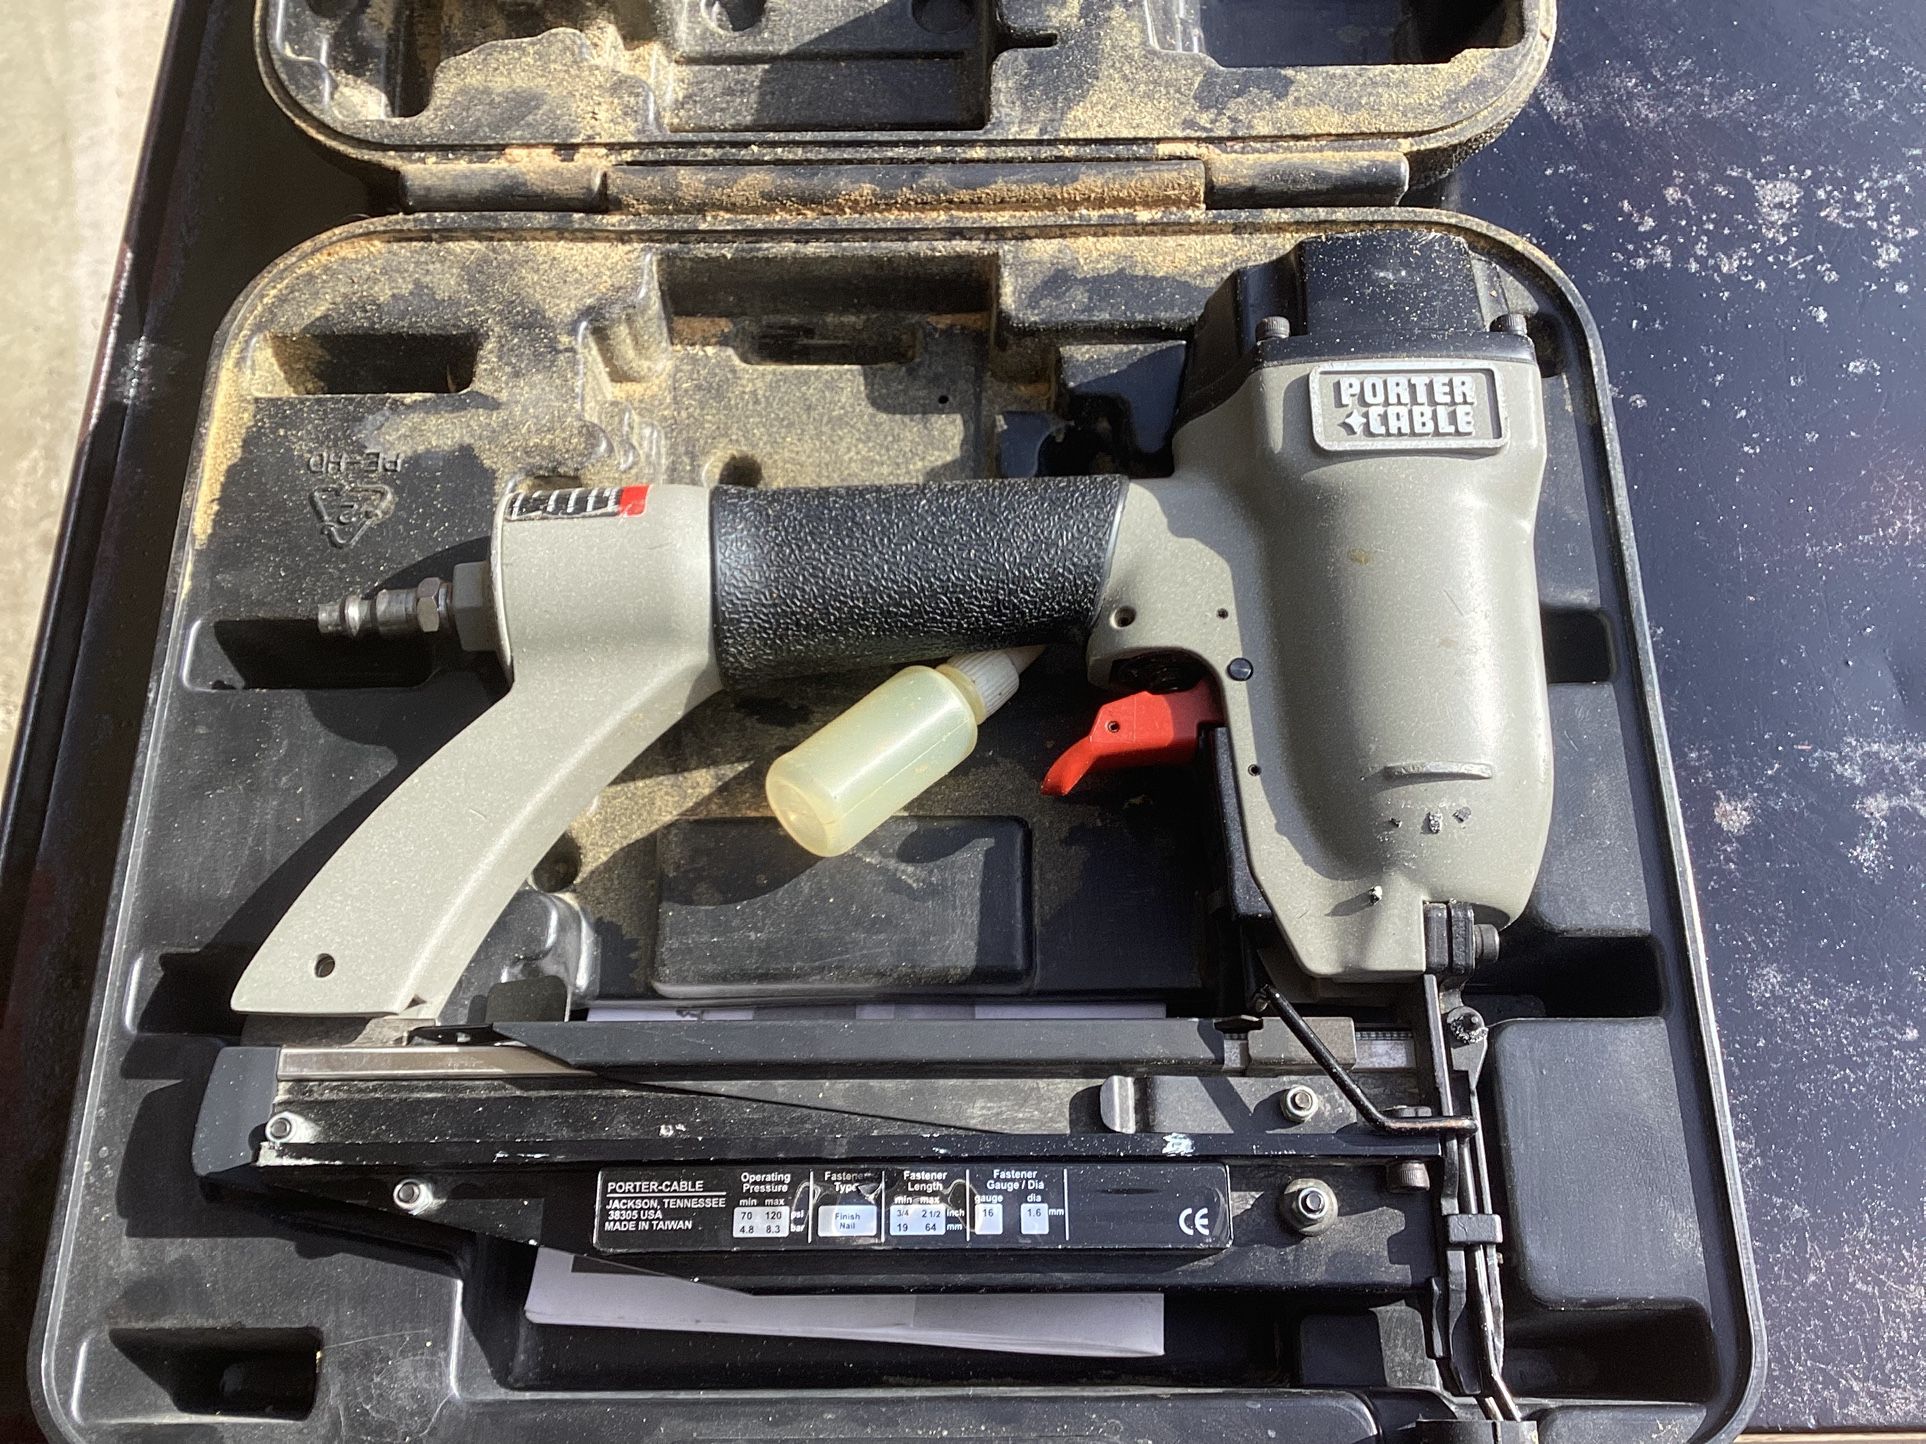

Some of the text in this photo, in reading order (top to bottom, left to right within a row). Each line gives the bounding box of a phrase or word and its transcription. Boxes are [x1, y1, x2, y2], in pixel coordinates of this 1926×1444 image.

[1338, 375, 1476, 406] PORTER
[1367, 404, 1475, 436] CABLE
[741, 1172, 791, 1184] Operating
[903, 1170, 947, 1180] Fastener
[993, 1169, 1038, 1179] Fastener
[607, 1180, 704, 1193] PORTER-CABLE
[743, 1183, 789, 1193] Pressure
[907, 1181, 943, 1194] Length
[986, 1180, 1020, 1192] Gauge
[1027, 1180, 1045, 1190] Dia
[606, 1197, 727, 1210] JACKSON, TENNESSEE
[739, 1197, 785, 1206] min max
[894, 1195, 940, 1204] min max
[974, 1193, 1042, 1204] gauge dia
[608, 1209, 663, 1220] 38305 USA
[740, 1211, 753, 1220] 70
[765, 1211, 782, 1220] 120
[835, 1212, 861, 1220] Finish
[896, 1208, 909, 1217] 3/4
[946, 1208, 965, 1217] inch
[982, 1208, 1065, 1217] 16 1.6 mm
[604, 1219, 693, 1231] MADE IN TAIWAN
[739, 1223, 805, 1234] 4.8 8.3 bar
[839, 1222, 856, 1230] Nail
[897, 1222, 963, 1232] 19 64 mm
